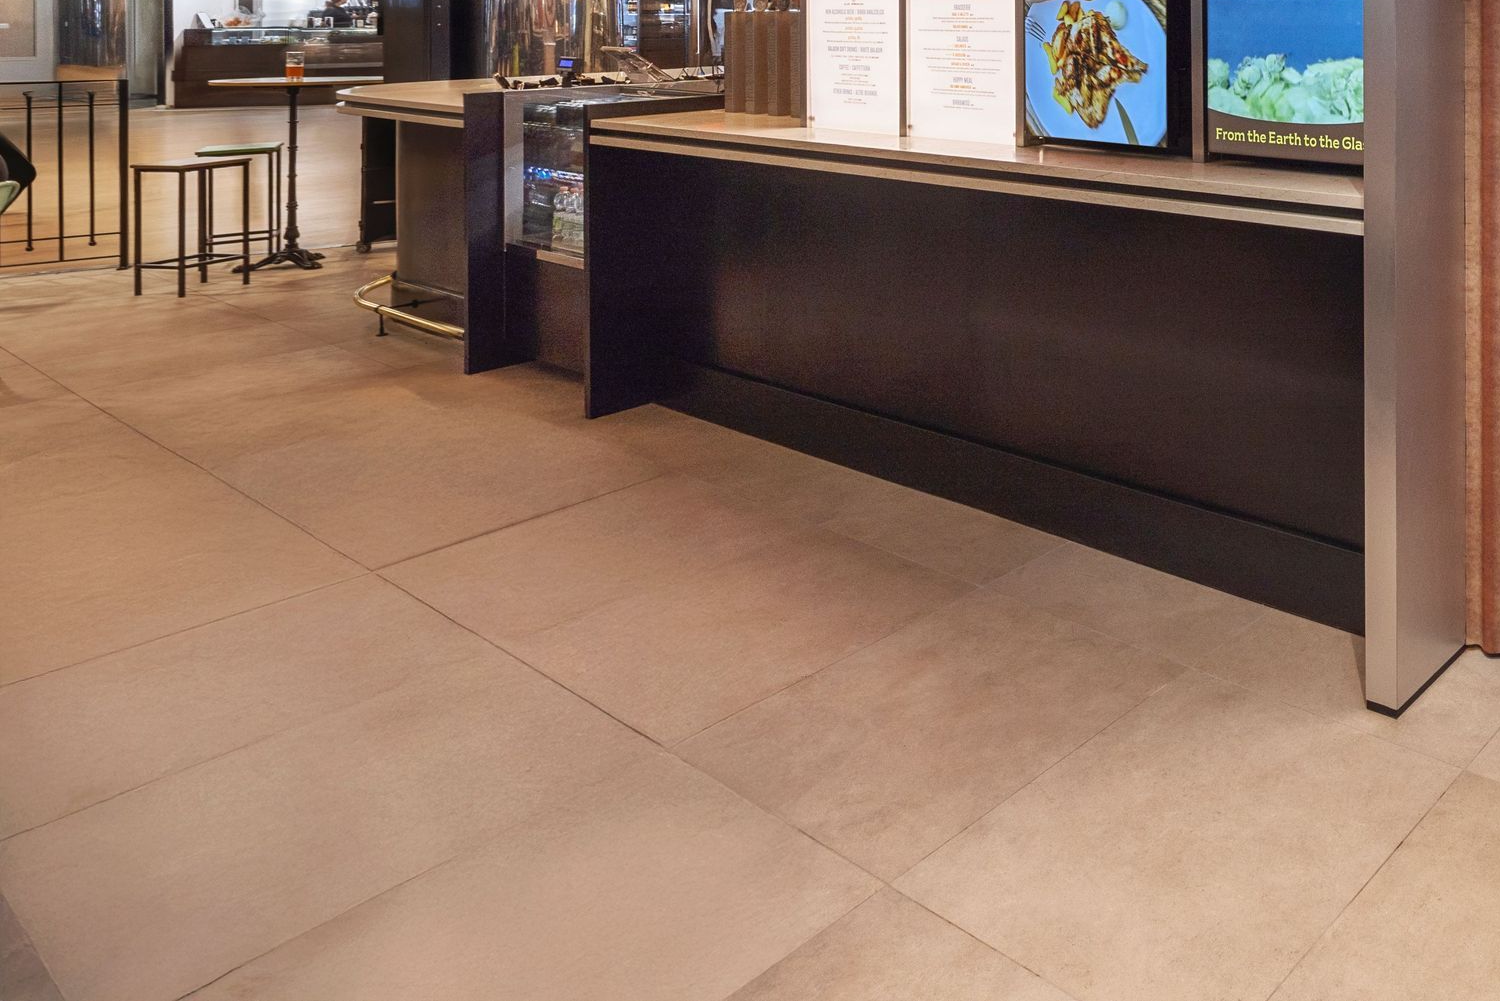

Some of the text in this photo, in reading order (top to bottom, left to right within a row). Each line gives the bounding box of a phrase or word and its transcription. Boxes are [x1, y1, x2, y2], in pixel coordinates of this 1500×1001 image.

[1215, 127, 1364, 151] From the Earth to the Gla
